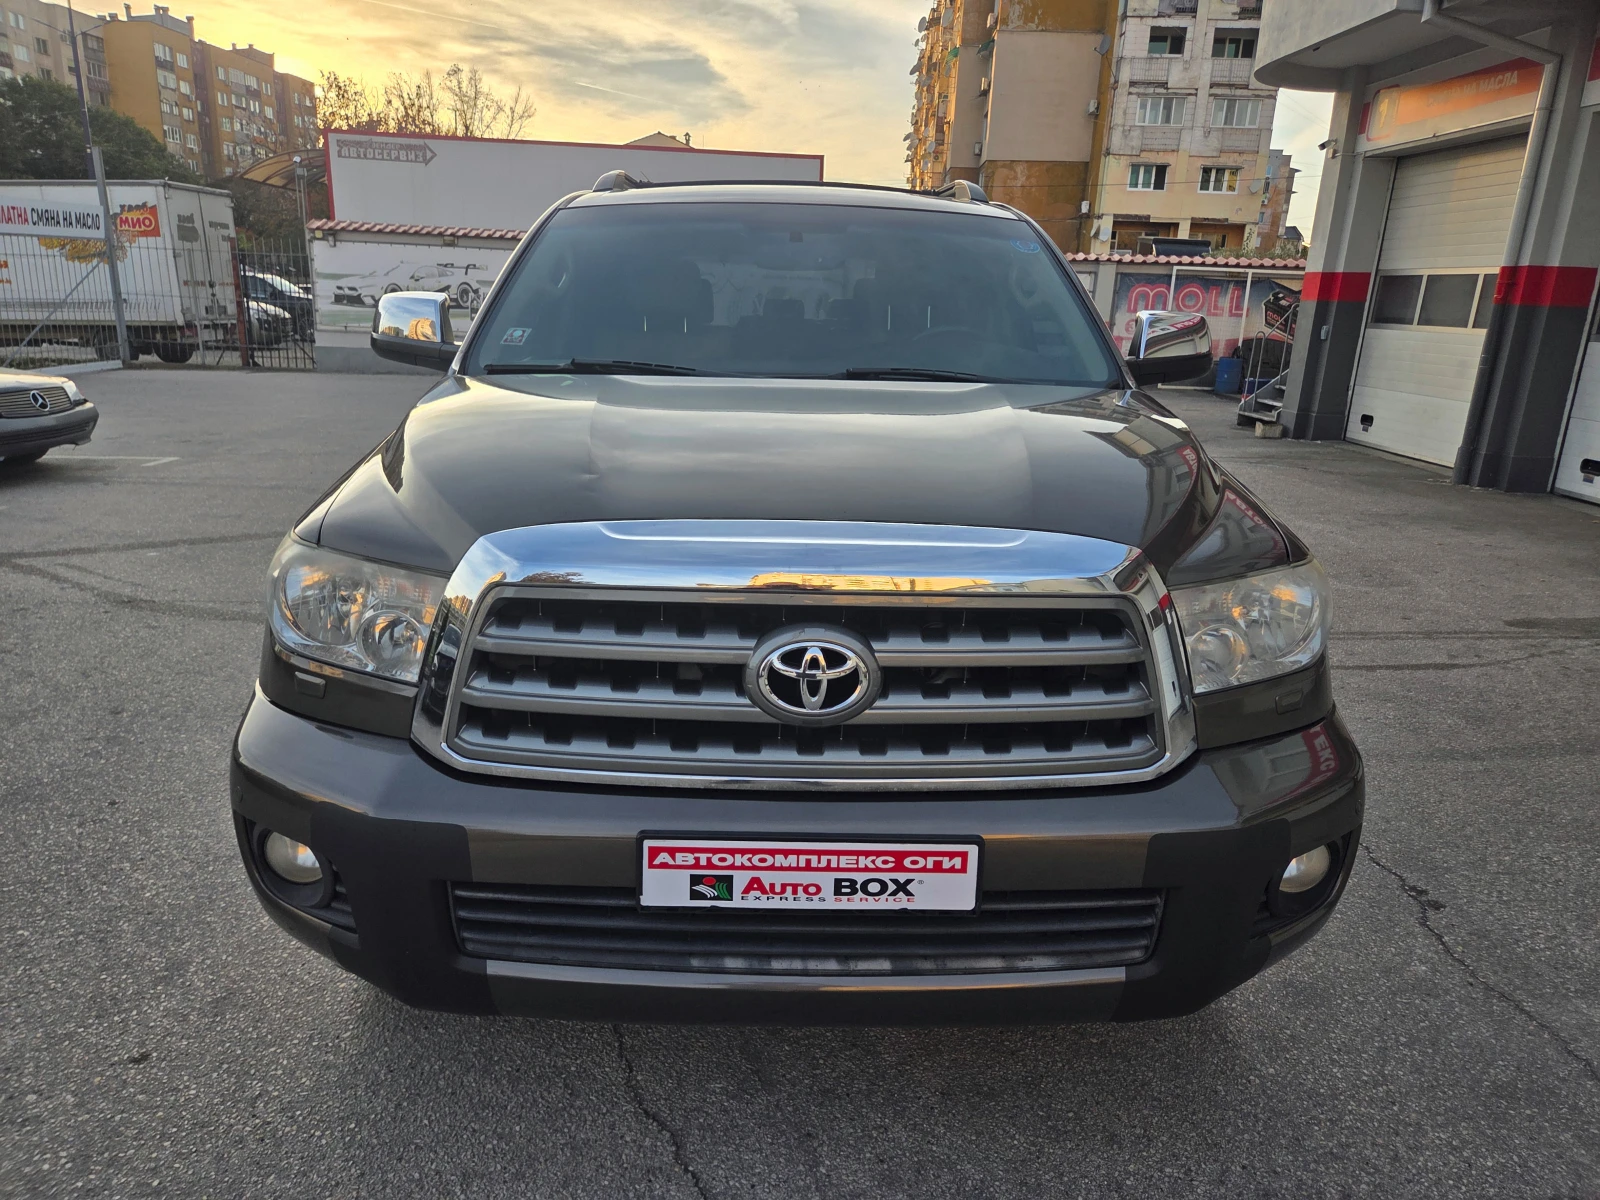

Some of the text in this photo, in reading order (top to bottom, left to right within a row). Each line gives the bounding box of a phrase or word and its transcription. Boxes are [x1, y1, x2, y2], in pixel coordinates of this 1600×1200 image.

[1479, 70, 1518, 92] МАСЛА
[341, 146, 424, 162] АВТОСЕРВИЗ
[0, 204, 101, 231] ЛАТНА СМЯНА НА МАСЛО
[118, 215, 154, 230] МИО
[652, 851, 963, 870] АВТОКОМПЛЕКС ОГИ
